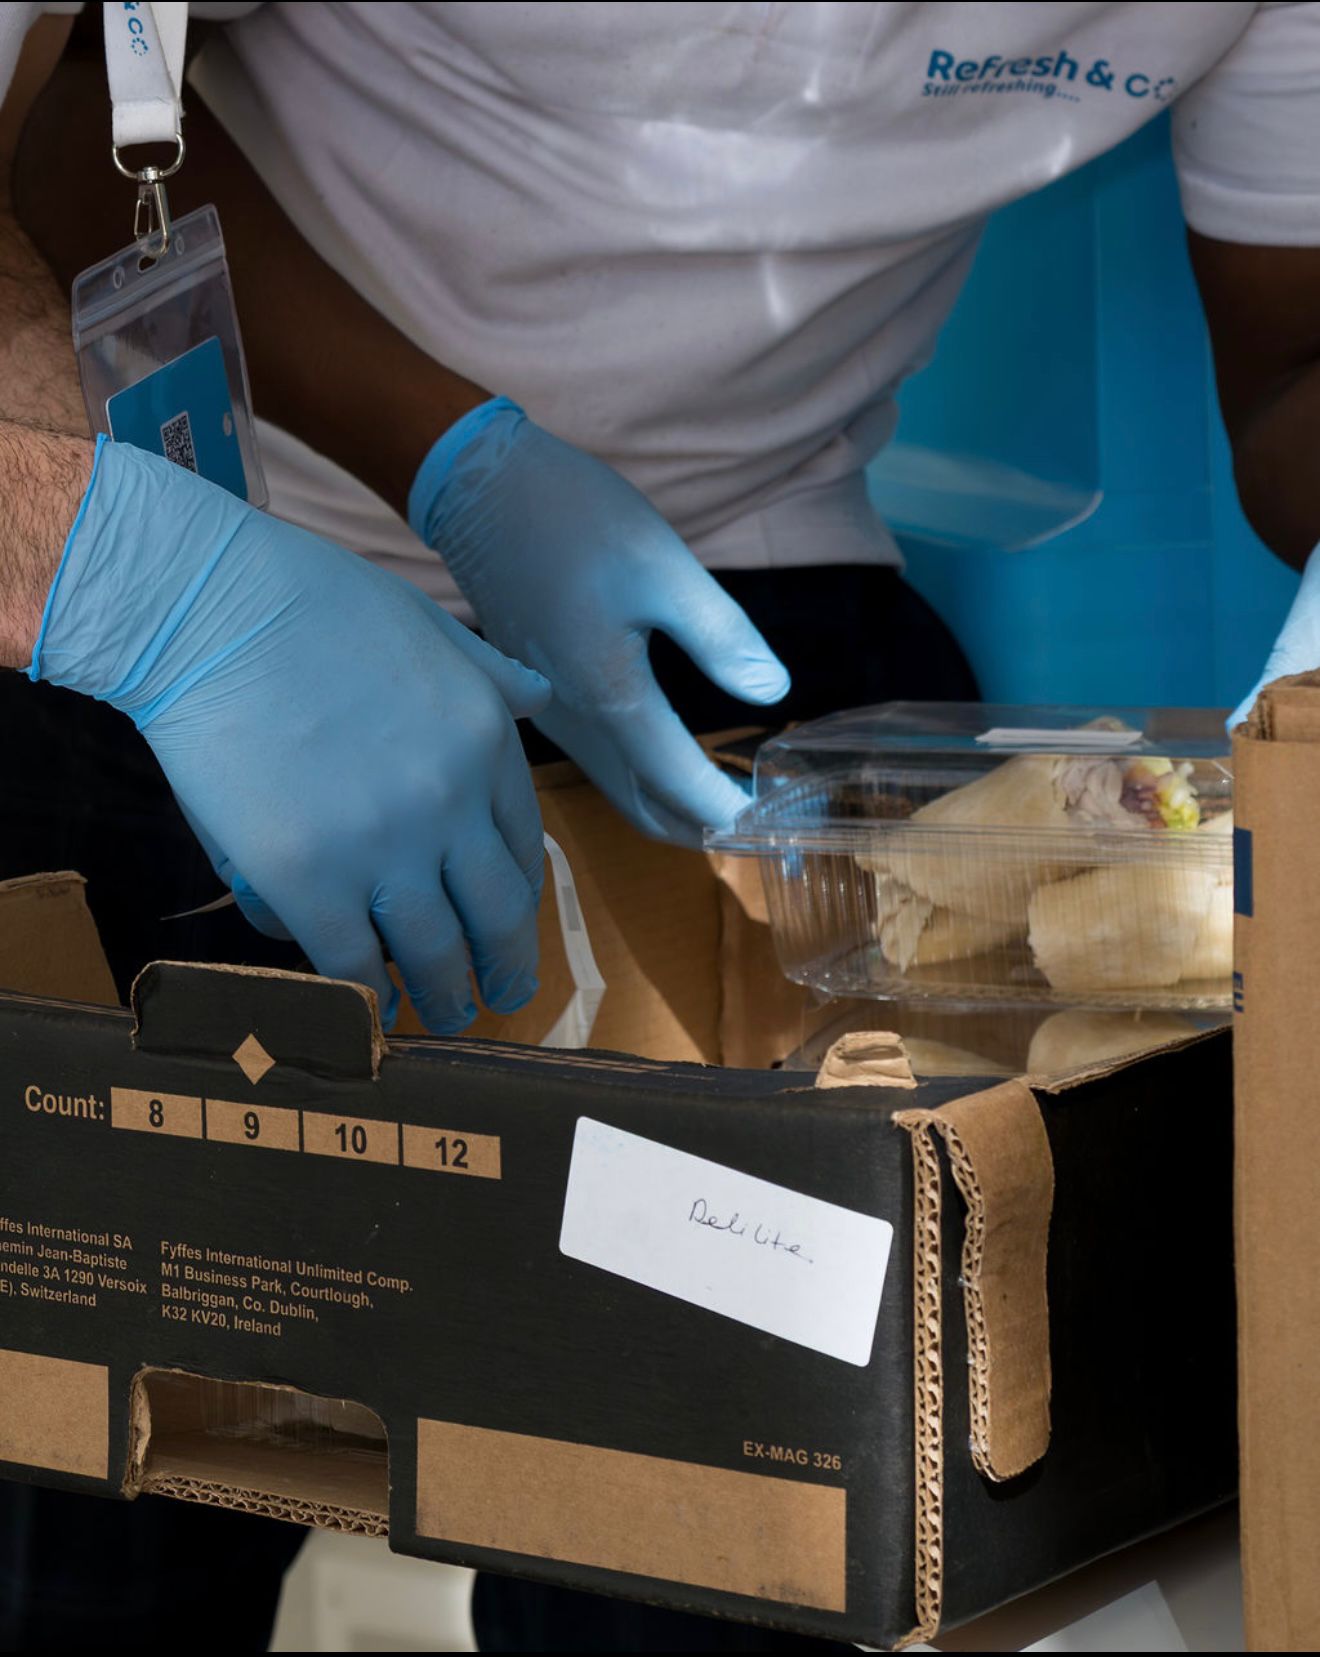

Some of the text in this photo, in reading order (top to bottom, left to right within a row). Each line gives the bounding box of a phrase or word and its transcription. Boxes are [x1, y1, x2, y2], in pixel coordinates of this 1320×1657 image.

[926, 49, 1079, 81] Refresh
[1085, 59, 1115, 91] &
[921, 82, 959, 98] Still
[24, 1084, 469, 1170] Count: 8 9 10 12
[26, 1221, 110, 1247] International
[112, 1233, 134, 1251] SA
[0, 1240, 129, 1270] emin Jean-Baptiste
[160, 1240, 414, 1294] Fyffes International Unlimited Comp.
[20, 1281, 97, 1307] Switzerland
[43, 1264, 61, 1281] 3A
[63, 1268, 95, 1287] 1290
[97, 1272, 149, 1295] Versoix
[161, 1261, 374, 1309] M1 Business Park, Courtlough,
[161, 1283, 319, 1323] Balbriggan, Co. Dublin,
[161, 1304, 282, 1336] K32 KV20, Ireland
[743, 1440, 842, 1471] EX-MAG 326
